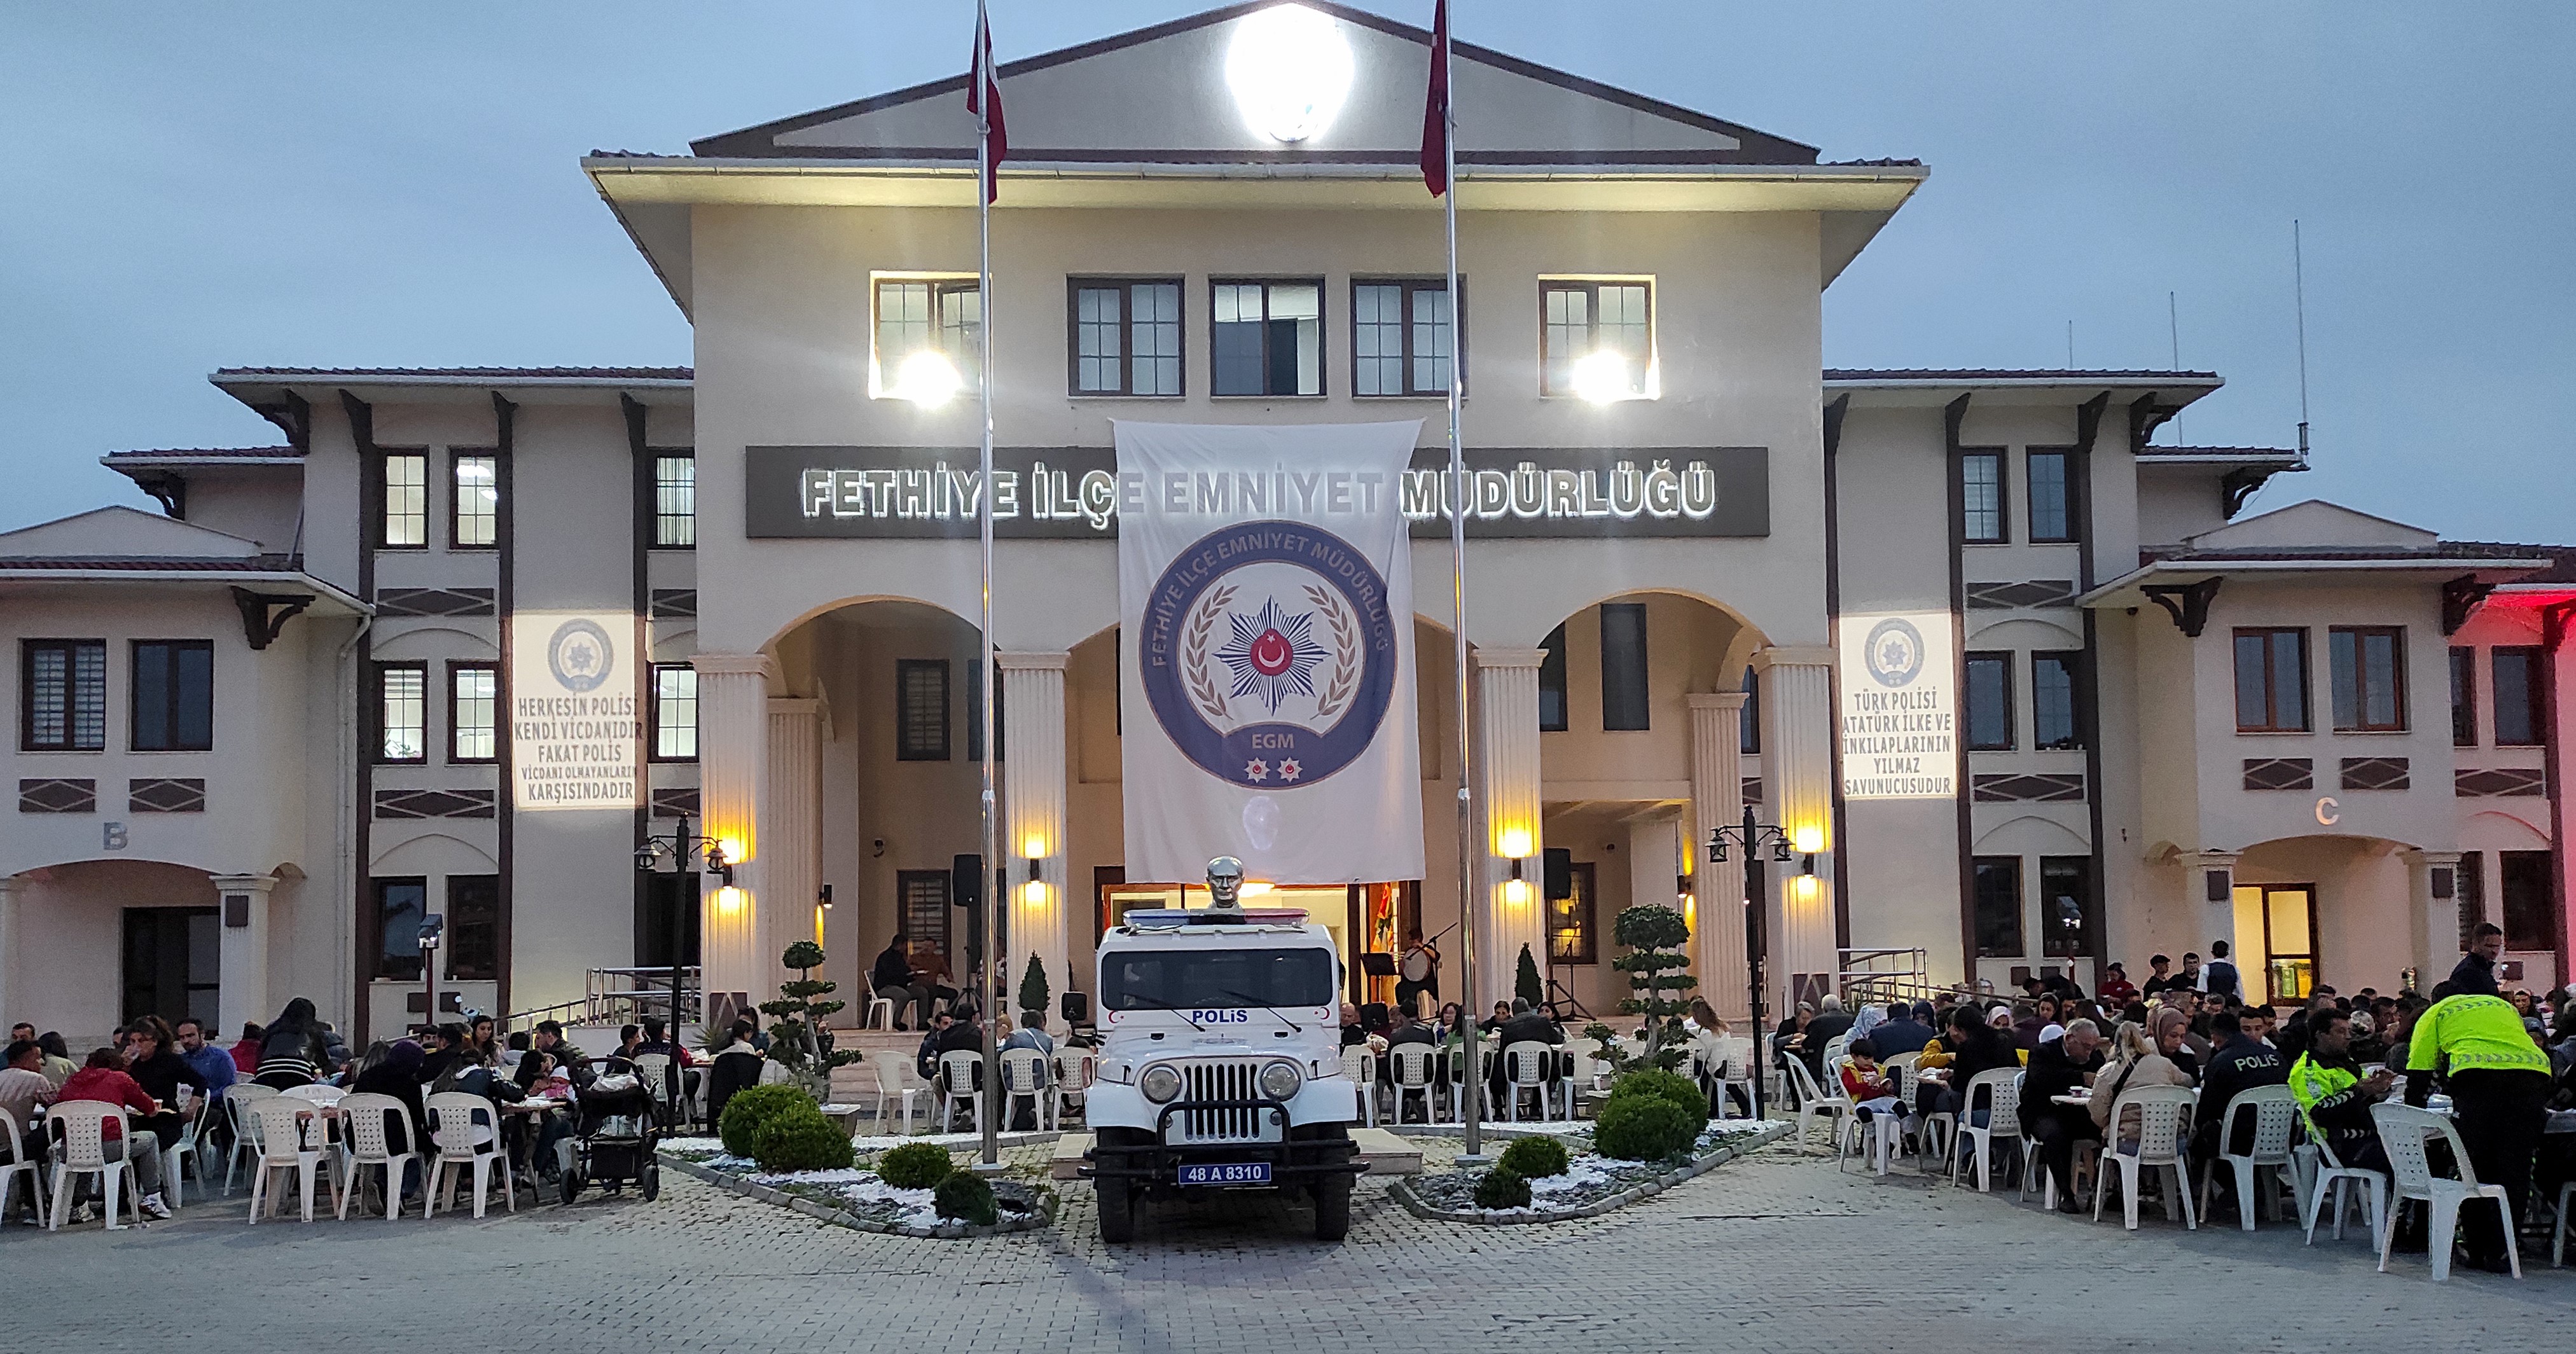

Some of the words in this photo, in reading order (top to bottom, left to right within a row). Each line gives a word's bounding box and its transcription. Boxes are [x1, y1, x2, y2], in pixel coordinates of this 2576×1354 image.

[801, 460, 1020, 519] FETHİYE
[1032, 460, 1145, 531] İLÇE
[1163, 462, 1384, 513] EMNİYET
[1152, 584, 1184, 667] FETHİYE
[1175, 549, 1217, 588] İLÇE
[1216, 530, 1309, 559] EMNİYET
[518, 692, 588, 717] HERKESİN
[1854, 688, 1888, 712] TÜRK
[1892, 686, 1937, 710] POLİSİ
[1843, 710, 1899, 733] ATATÜRK
[1903, 710, 1932, 731] İLKE
[1935, 713, 1951, 731] VE
[1251, 733, 1294, 749] EGM
[1843, 733, 1950, 754] İNKILAPLARININ
[538, 744, 579, 763] FAKAT
[1874, 757, 1920, 774] YILMAZ
[528, 782, 634, 804] KARŞISINDADIR
[1845, 777, 1951, 795] SAVUNUCUSUDUR
[2315, 796, 2339, 825] C
[103, 822, 128, 850] B
[1188, 1167, 1207, 1181] 48
[1210, 1166, 1222, 1180] A
[1226, 1165, 1262, 1180] 8310
